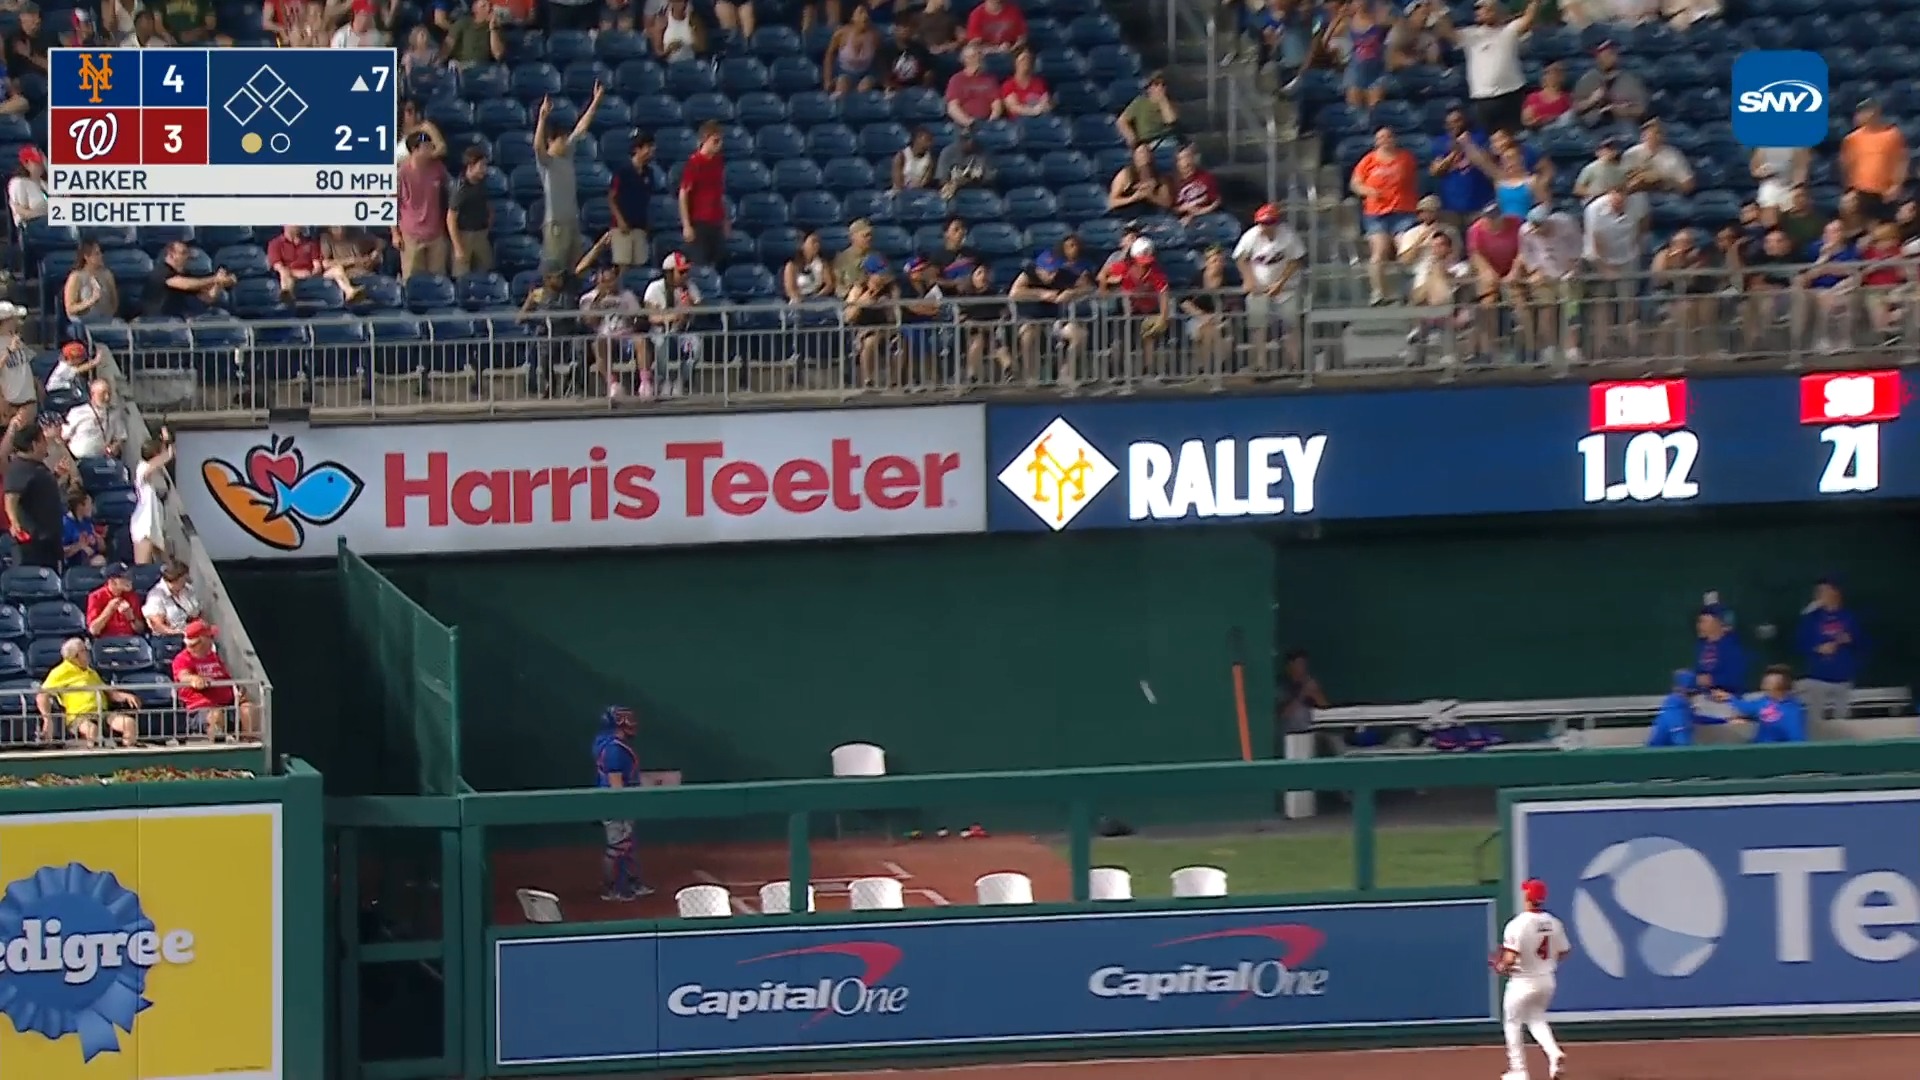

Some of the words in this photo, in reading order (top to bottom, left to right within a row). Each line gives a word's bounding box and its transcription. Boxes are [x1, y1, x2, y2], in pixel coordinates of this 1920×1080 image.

[384, 446, 661, 528] Harris
[665, 438, 960, 517] Teeter
[1128, 435, 1328, 520] RALEY
[1577, 430, 1699, 502] 1.02
[1819, 423, 1880, 493] 21
[1536, 935, 1549, 961] 4
